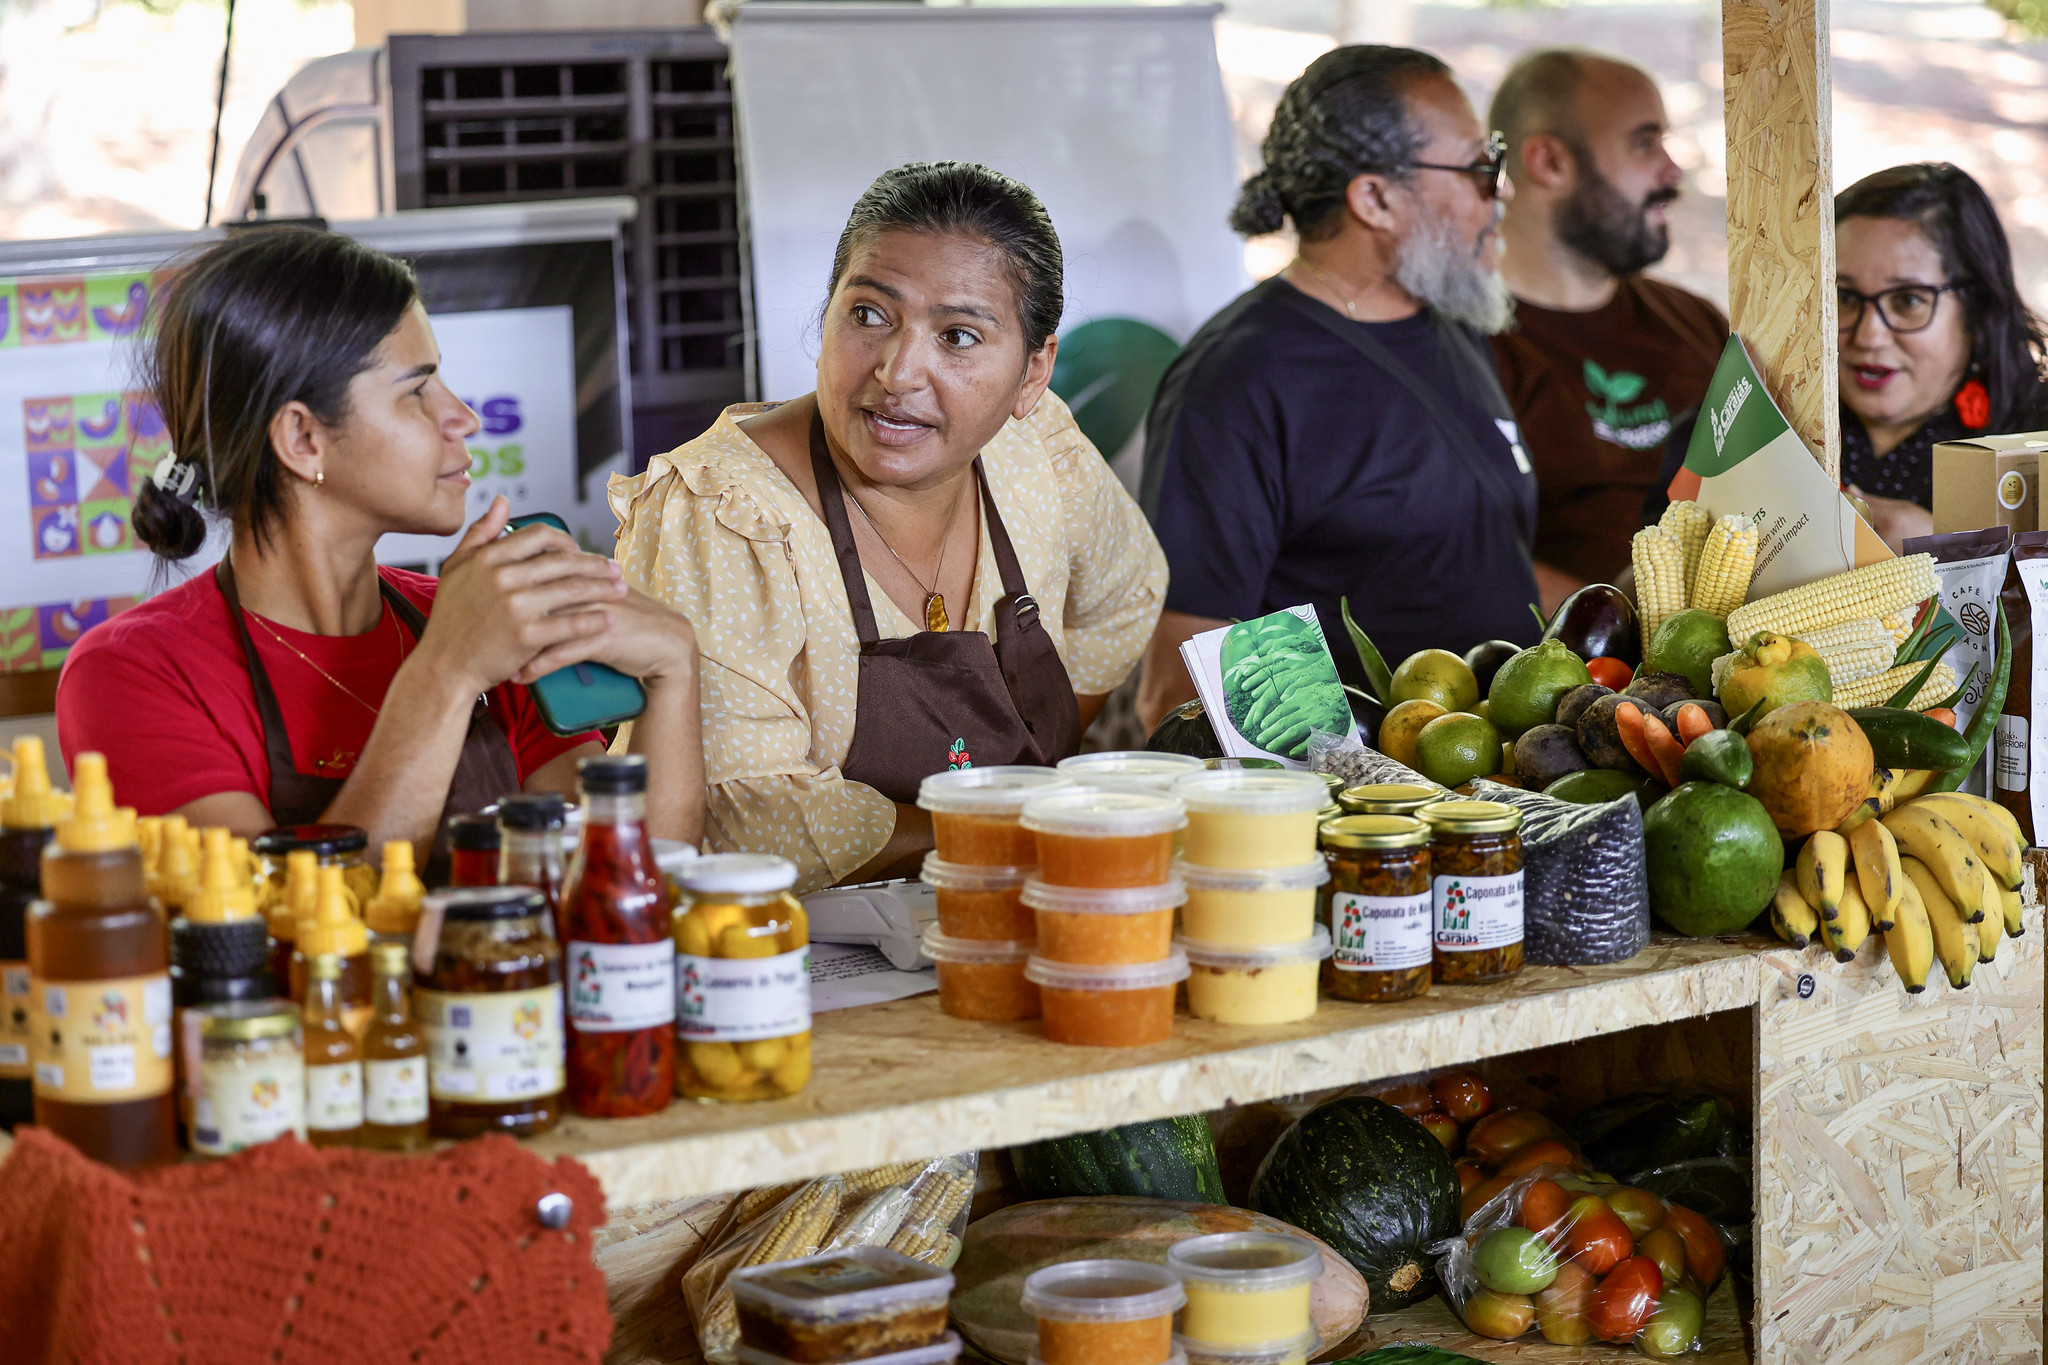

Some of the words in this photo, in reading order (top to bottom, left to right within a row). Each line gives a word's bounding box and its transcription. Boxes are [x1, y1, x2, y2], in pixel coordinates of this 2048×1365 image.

[1720, 376, 1750, 429] Carajás
[1770, 515, 1787, 536] with
[1782, 512, 1810, 543] Impact
[1466, 885, 1506, 901] Caponata
[1508, 883, 1516, 895] de
[1362, 905, 1405, 921] Caponata
[1408, 904, 1417, 916] de
[1437, 931, 1479, 946] Carajás
[1334, 949, 1374, 965] Carajás
